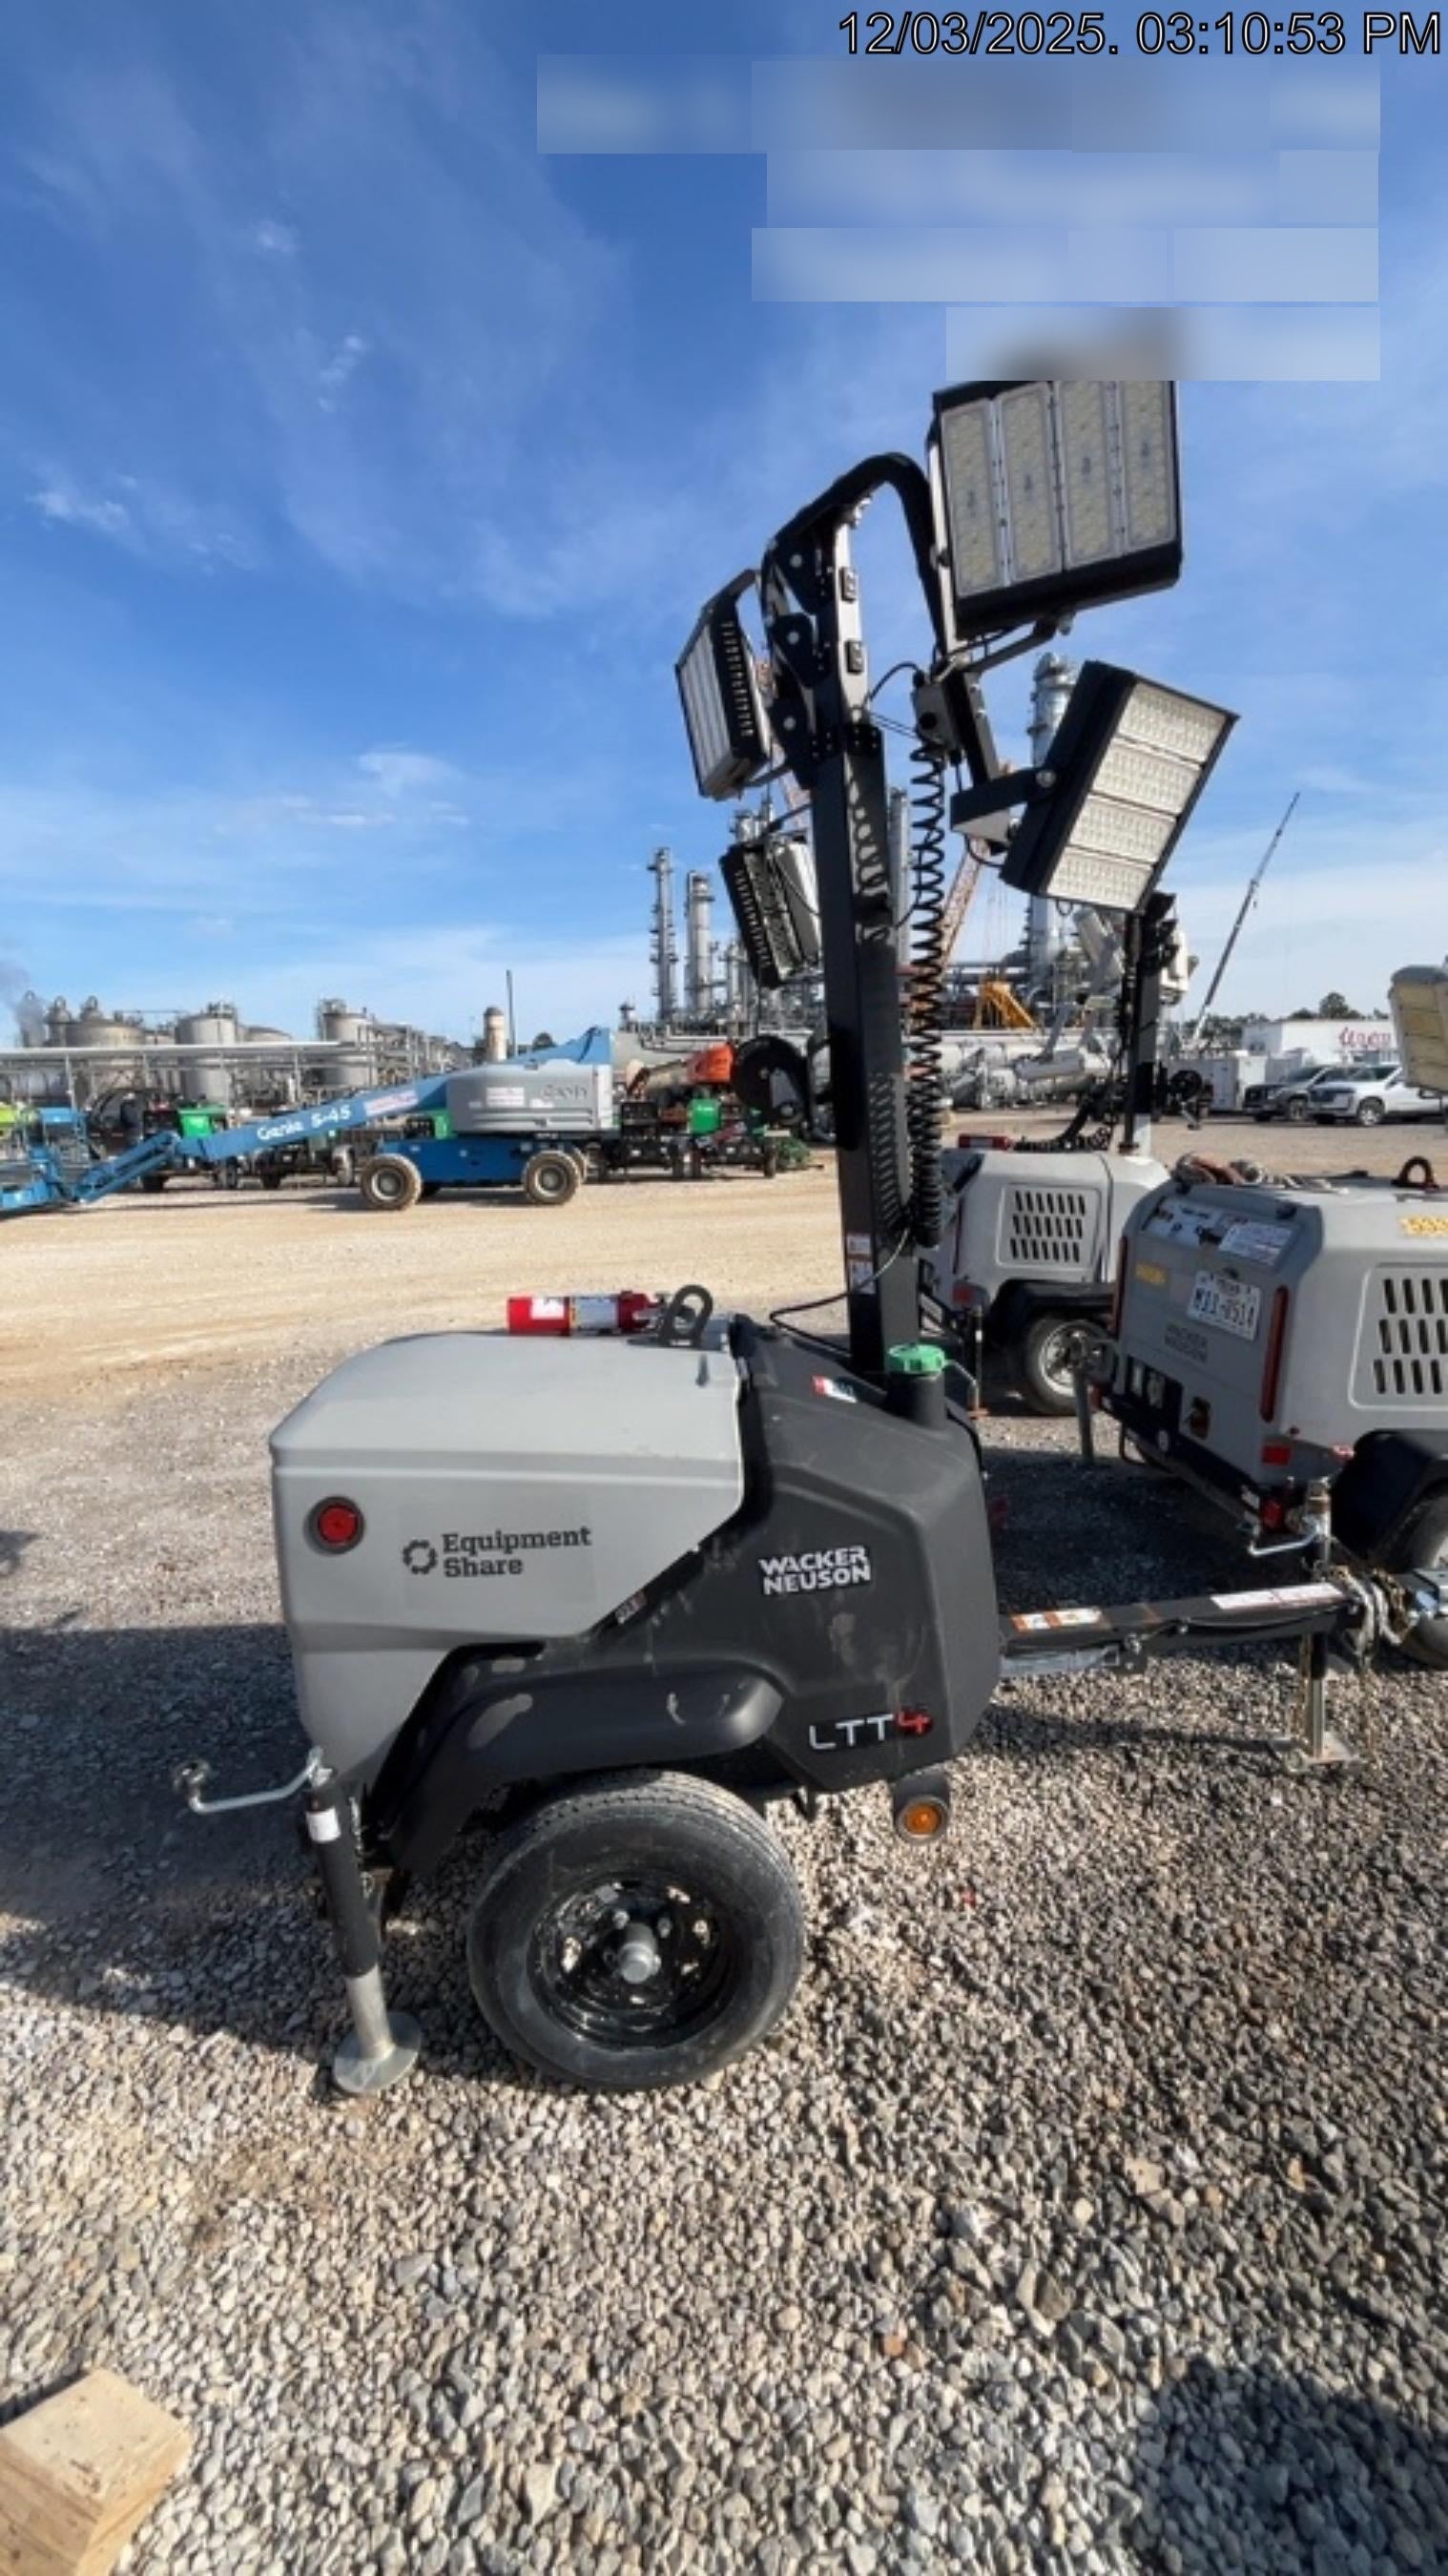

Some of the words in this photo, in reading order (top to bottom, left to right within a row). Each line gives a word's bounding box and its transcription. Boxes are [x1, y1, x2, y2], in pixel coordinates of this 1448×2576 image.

[311, 1104, 351, 1128] S-45
[442, 1527, 591, 1556] Equipment
[443, 1556, 524, 1578] Share
[758, 1545, 869, 1576] WACKER
[763, 1565, 871, 1595] NEUSON
